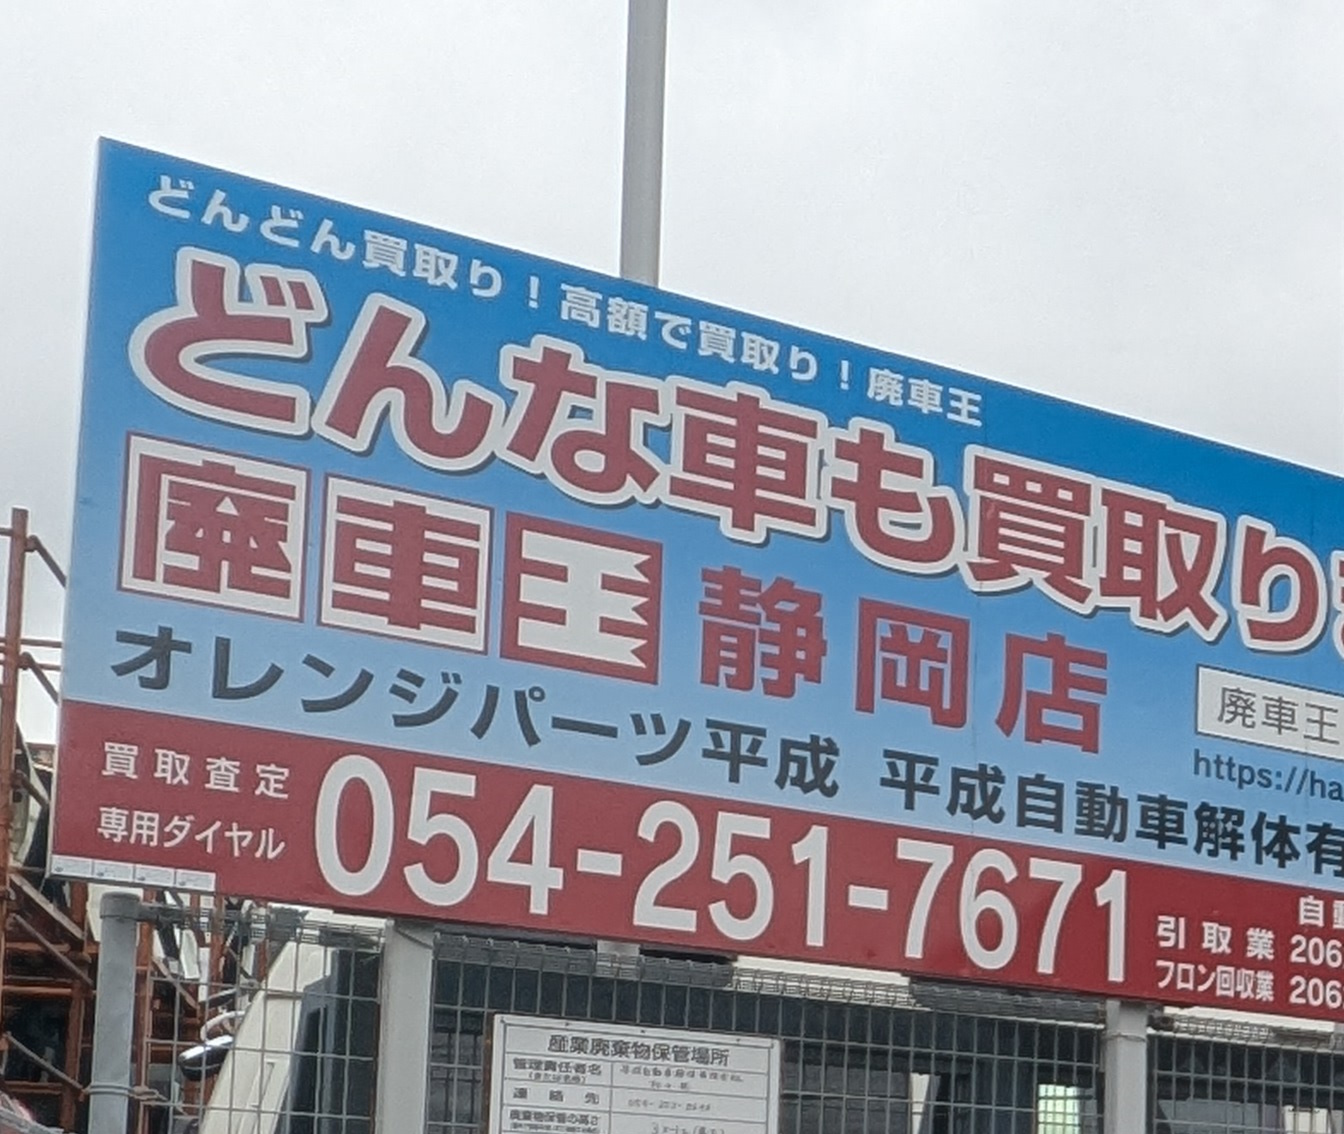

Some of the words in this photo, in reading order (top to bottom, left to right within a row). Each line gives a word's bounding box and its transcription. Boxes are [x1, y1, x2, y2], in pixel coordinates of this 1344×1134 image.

[117, 432, 1109, 755] 廃車王静岡店
[110, 625, 841, 799] オレンジパーツ平成
[1217, 686, 1342, 747] 廃車王
[101, 740, 291, 800] 買取査定
[97, 806, 287, 862] 専用ダイヤル
[314, 754, 1129, 983] 054-251-7671
[1157, 915, 1275, 961] 引取業
[1156, 960, 1275, 1002] フロン回収業
